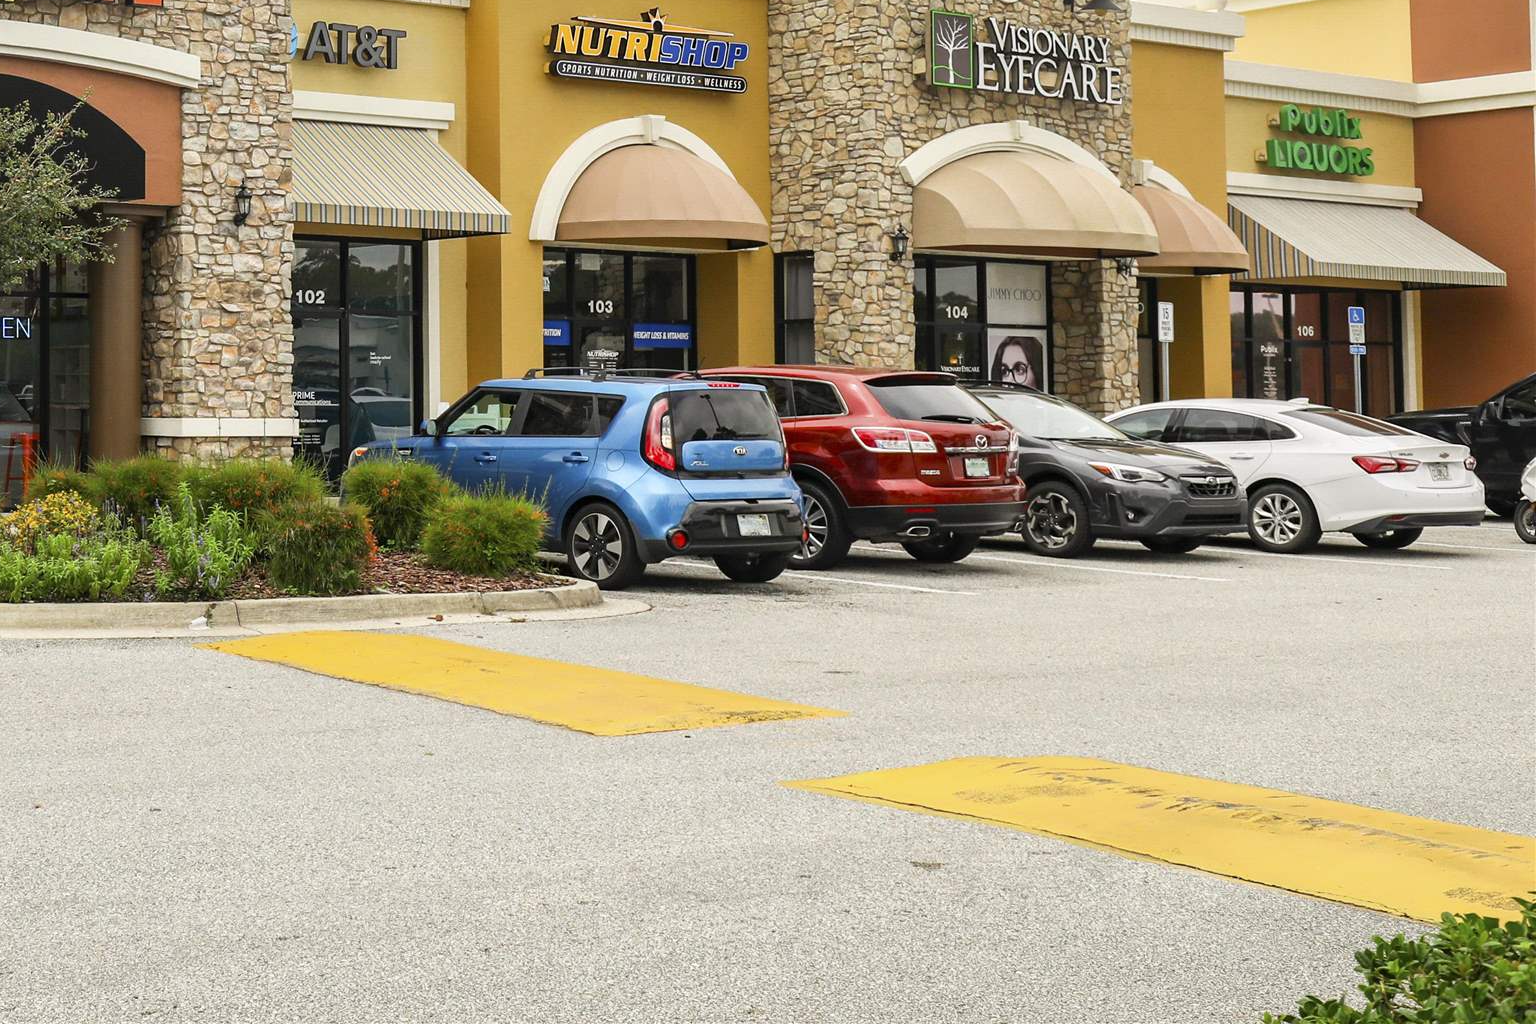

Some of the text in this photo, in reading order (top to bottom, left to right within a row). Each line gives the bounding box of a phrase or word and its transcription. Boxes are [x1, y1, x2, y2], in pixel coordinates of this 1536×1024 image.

[303, 21, 407, 69] AT&T
[553, 23, 749, 70] NUTRISHOP
[988, 17, 1111, 63] VISIONARY
[561, 63, 742, 89] SPORTS NUTRITION WEIGHT LOSS WELLNESS
[975, 42, 1123, 105] EYECARE
[1280, 104, 1362, 139] Publix
[1267, 139, 1375, 176] LIQUORS
[295, 289, 326, 304] 102
[587, 300, 614, 314] 103
[988, 288, 1042, 301] JIMMY CHOO
[945, 306, 969, 319] 104
[1297, 326, 1314, 336] 106
[293, 391, 315, 400] PRIME
